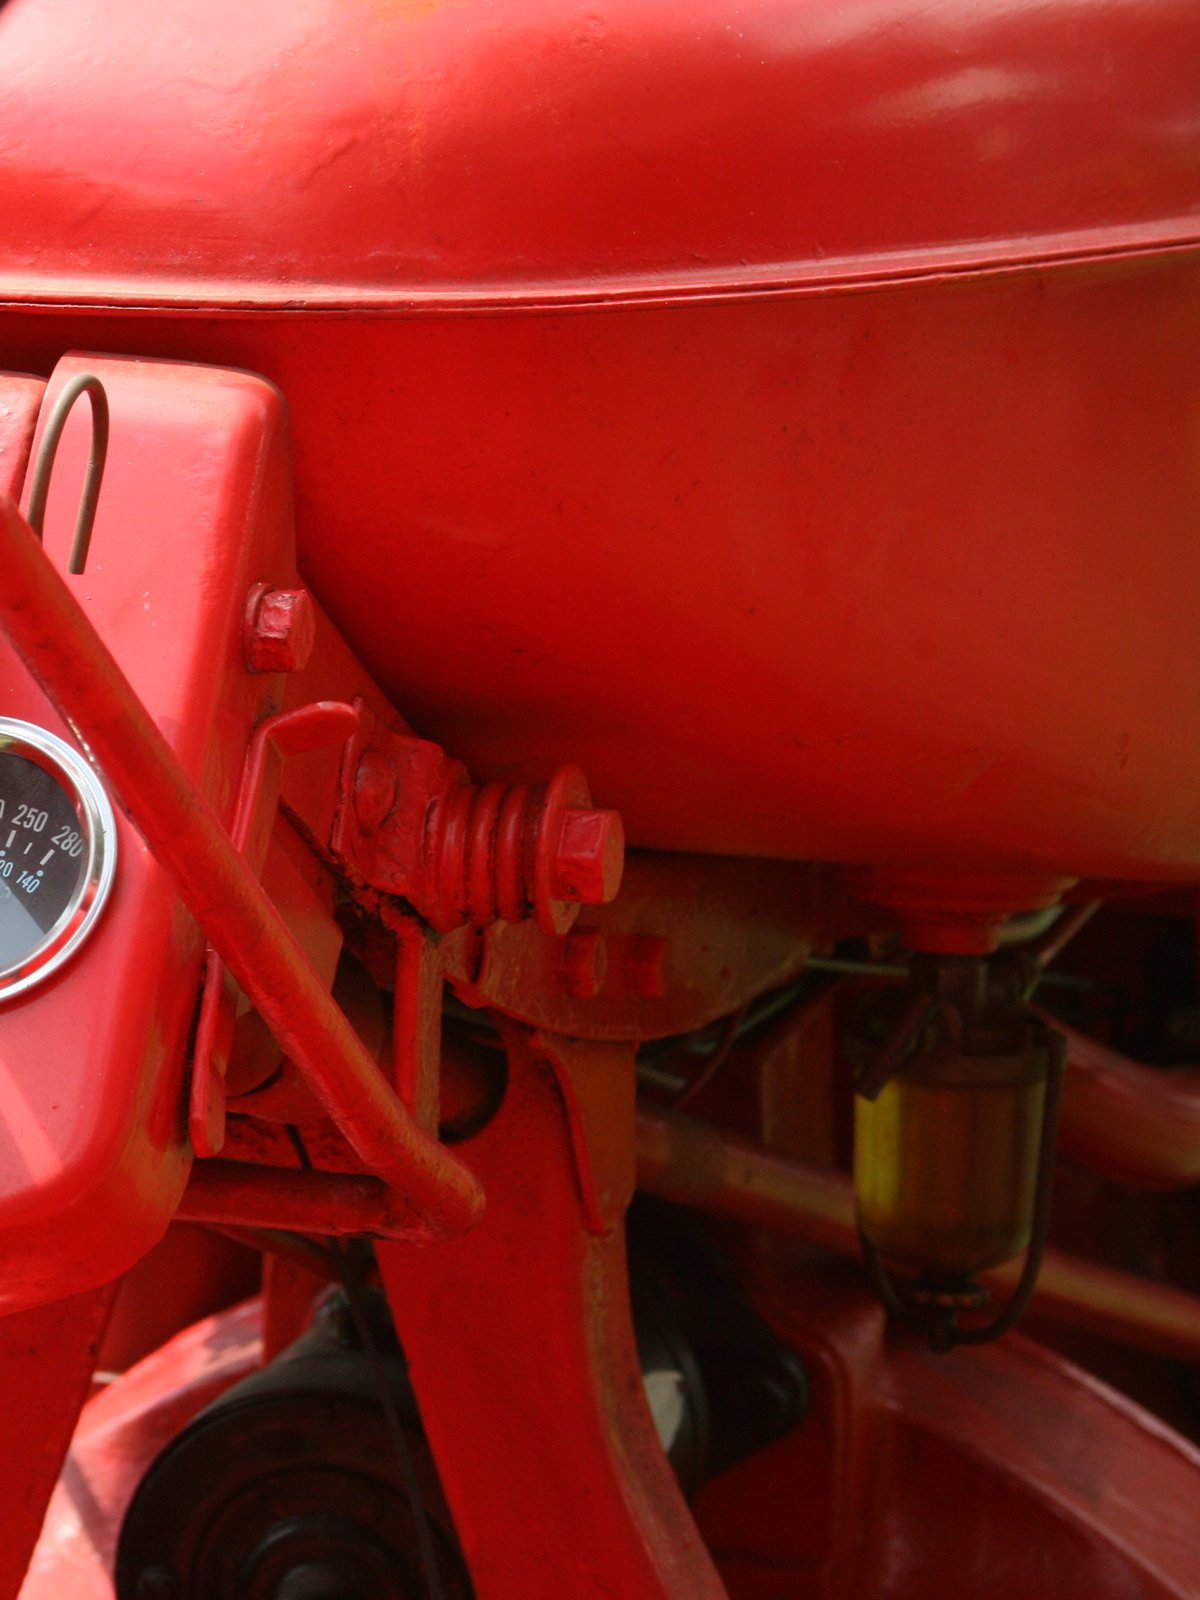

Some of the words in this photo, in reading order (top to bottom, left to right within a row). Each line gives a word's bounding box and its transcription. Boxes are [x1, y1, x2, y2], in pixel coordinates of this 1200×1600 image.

[11, 804, 49, 832] 250
[51, 825, 82, 857] 280
[16, 870, 40, 893] 140
